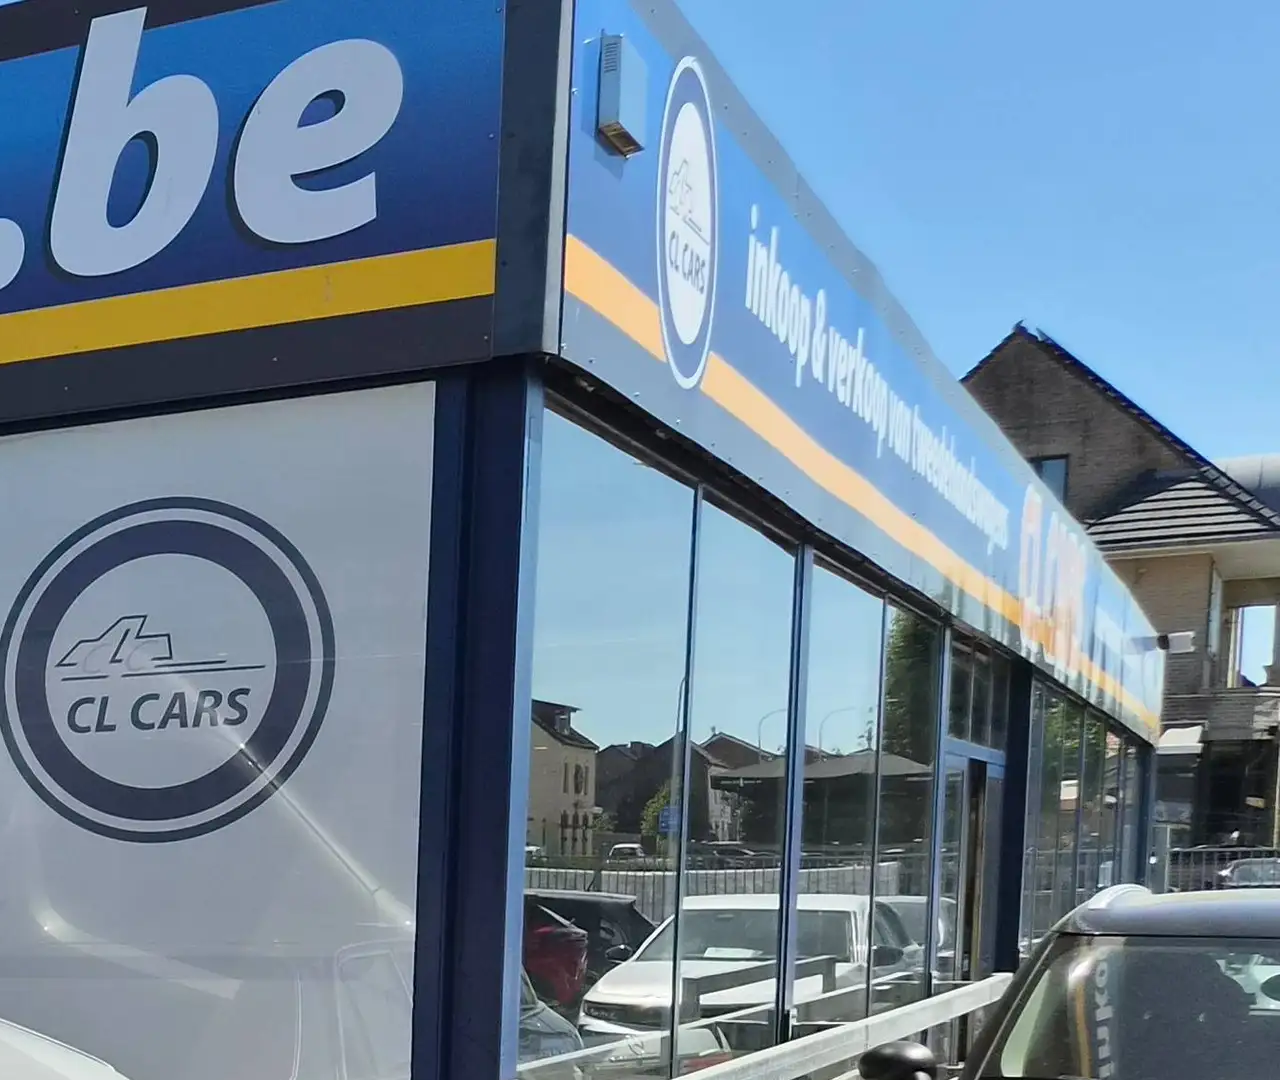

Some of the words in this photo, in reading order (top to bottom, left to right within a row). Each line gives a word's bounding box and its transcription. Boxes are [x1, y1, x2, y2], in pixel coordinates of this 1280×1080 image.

[669, 230, 679, 272] CL
[682, 243, 705, 295] CARS
[745, 203, 811, 388] inkoop
[811, 288, 826, 384] &
[828, 326, 888, 459] verkoop
[66, 696, 116, 734] CL
[130, 687, 251, 731] CARS
